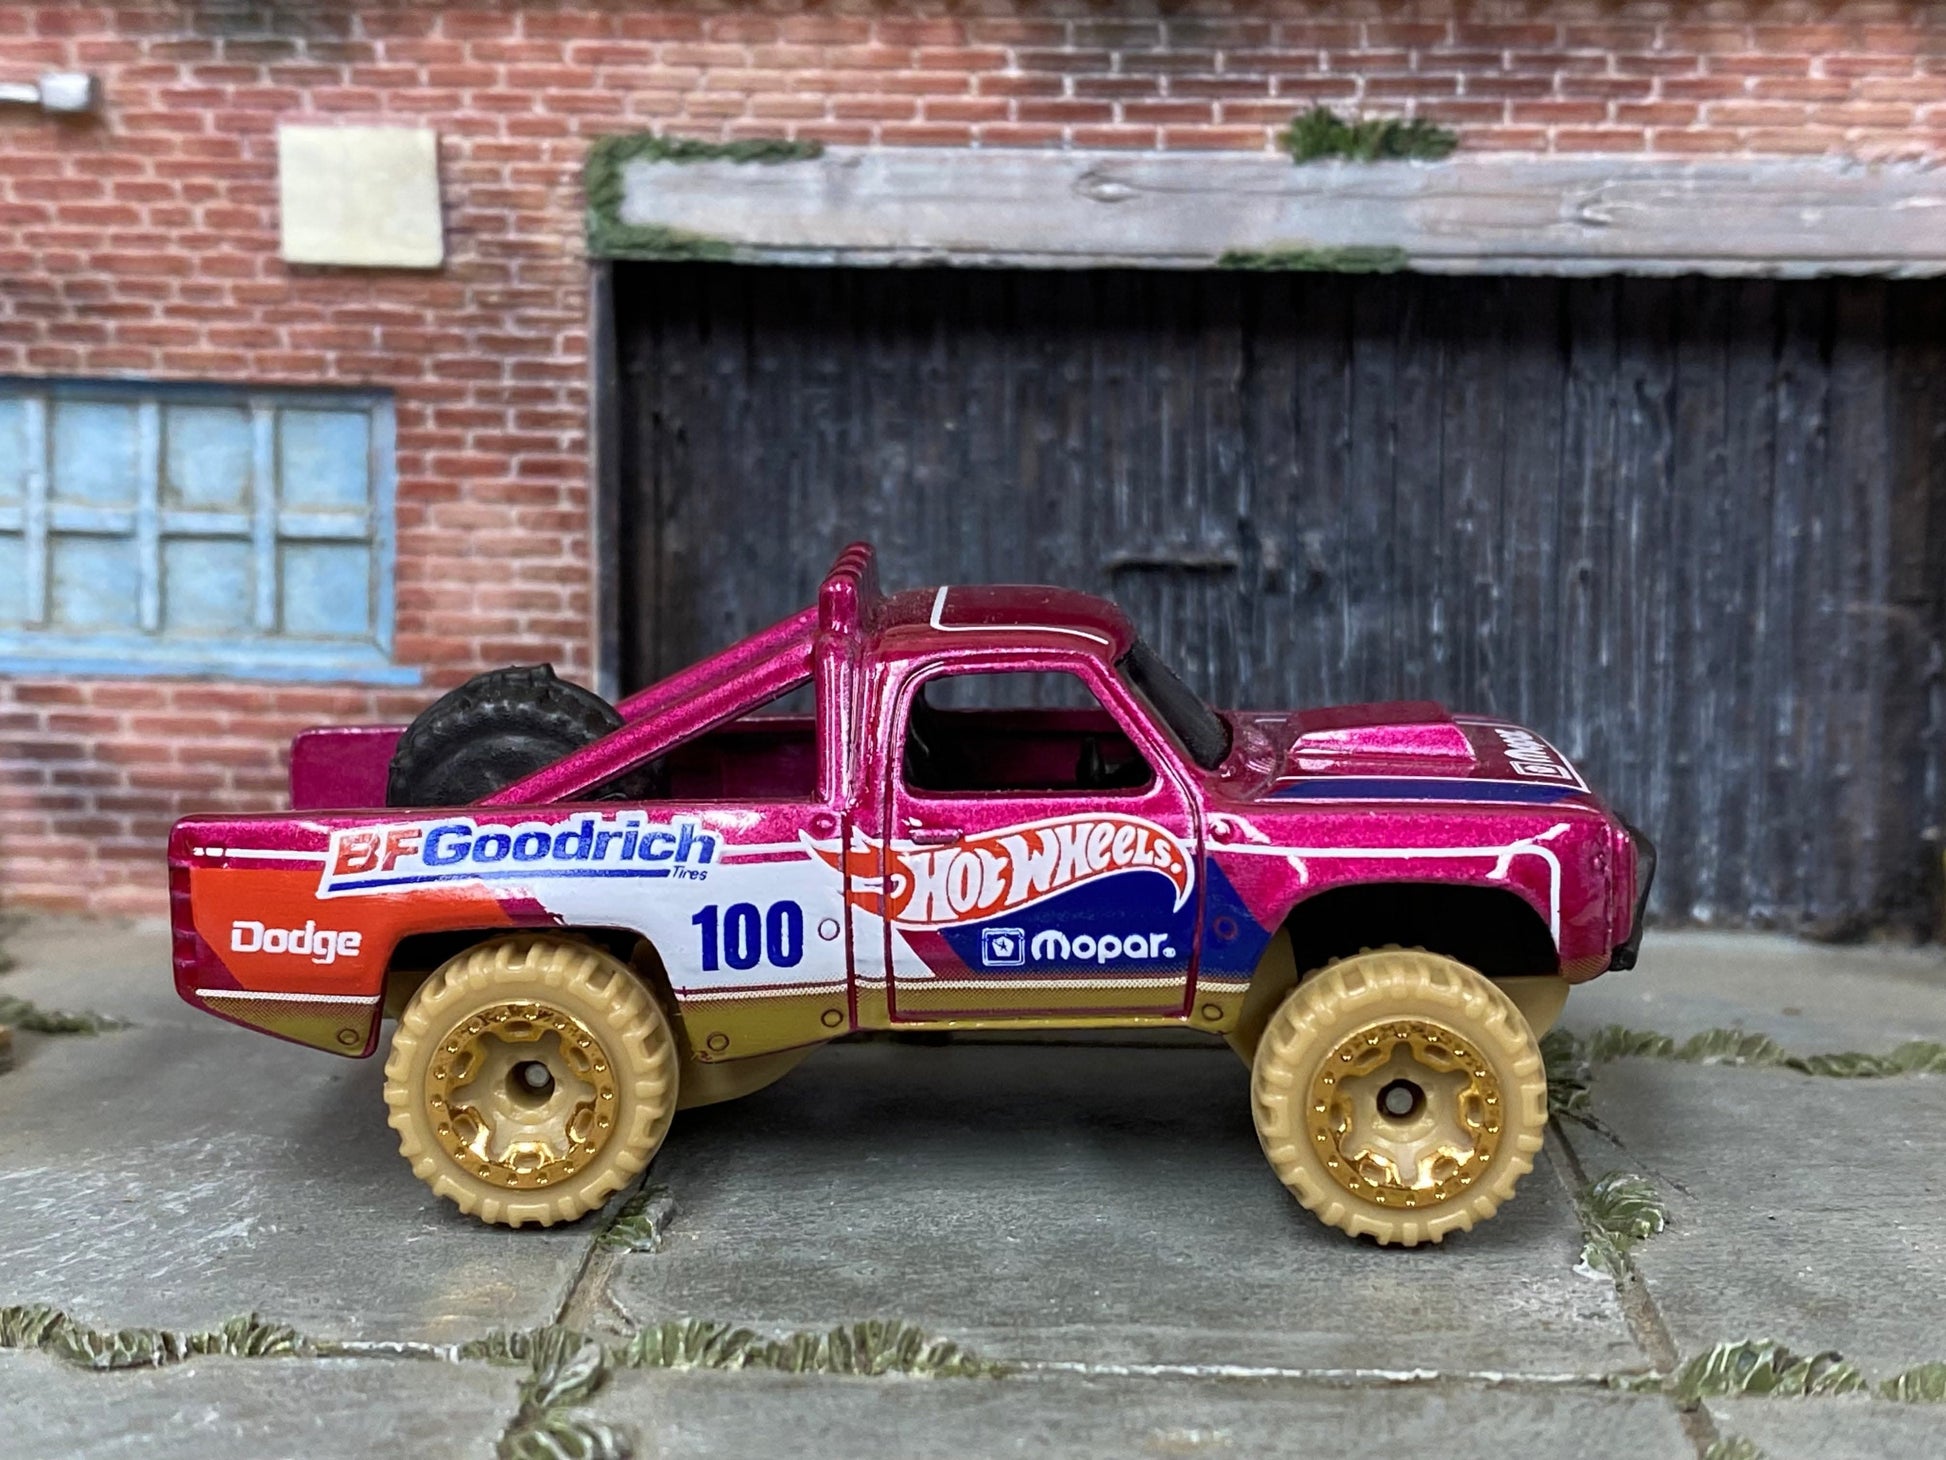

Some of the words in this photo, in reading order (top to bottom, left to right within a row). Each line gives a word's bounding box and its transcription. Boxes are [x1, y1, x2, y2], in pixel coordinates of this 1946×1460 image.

[333, 819, 716, 876] BFGoodrich
[672, 864, 709, 882] Tires
[230, 920, 362, 964] Dodge
[692, 901, 803, 971] 100
